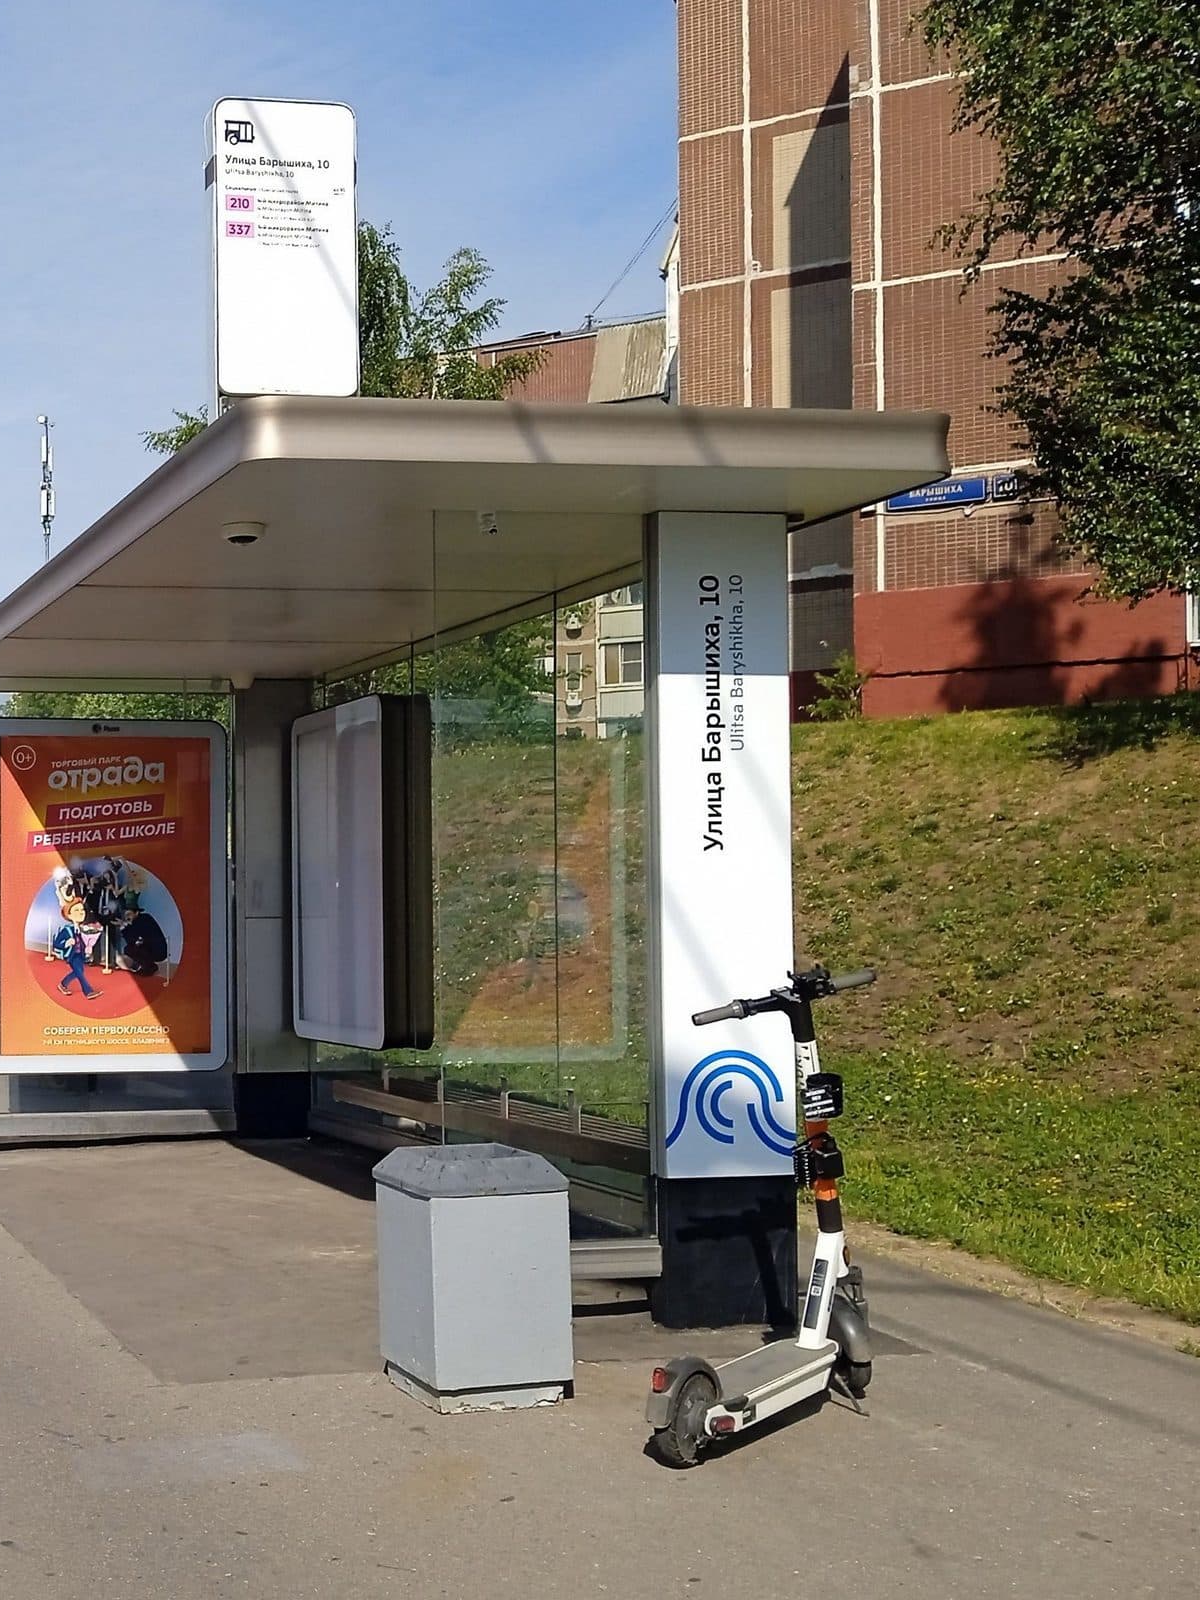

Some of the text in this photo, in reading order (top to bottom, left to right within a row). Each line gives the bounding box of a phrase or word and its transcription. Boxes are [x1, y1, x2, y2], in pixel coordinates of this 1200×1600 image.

[225, 154, 330, 170] Улица Барышиха, 10
[286, 170, 295, 178] 10
[230, 197, 250, 209] 210
[229, 223, 251, 235] 337
[729, 574, 747, 751] Ulitsa Baryshikha, 10
[699, 574, 725, 851] Улица Барышиха, 10
[16, 751, 32, 763] 0+
[51, 756, 121, 769] ТОРГОВЫЙ ПАРК
[47, 756, 165, 794] отрада
[59, 800, 153, 820] ПОДГОТОВЬ
[32, 822, 176, 847] РЕБЕНКА К ШКОЛЕ
[43, 1026, 170, 1035] СОБЕРЕМ ПЕРВОКЛАССНО
